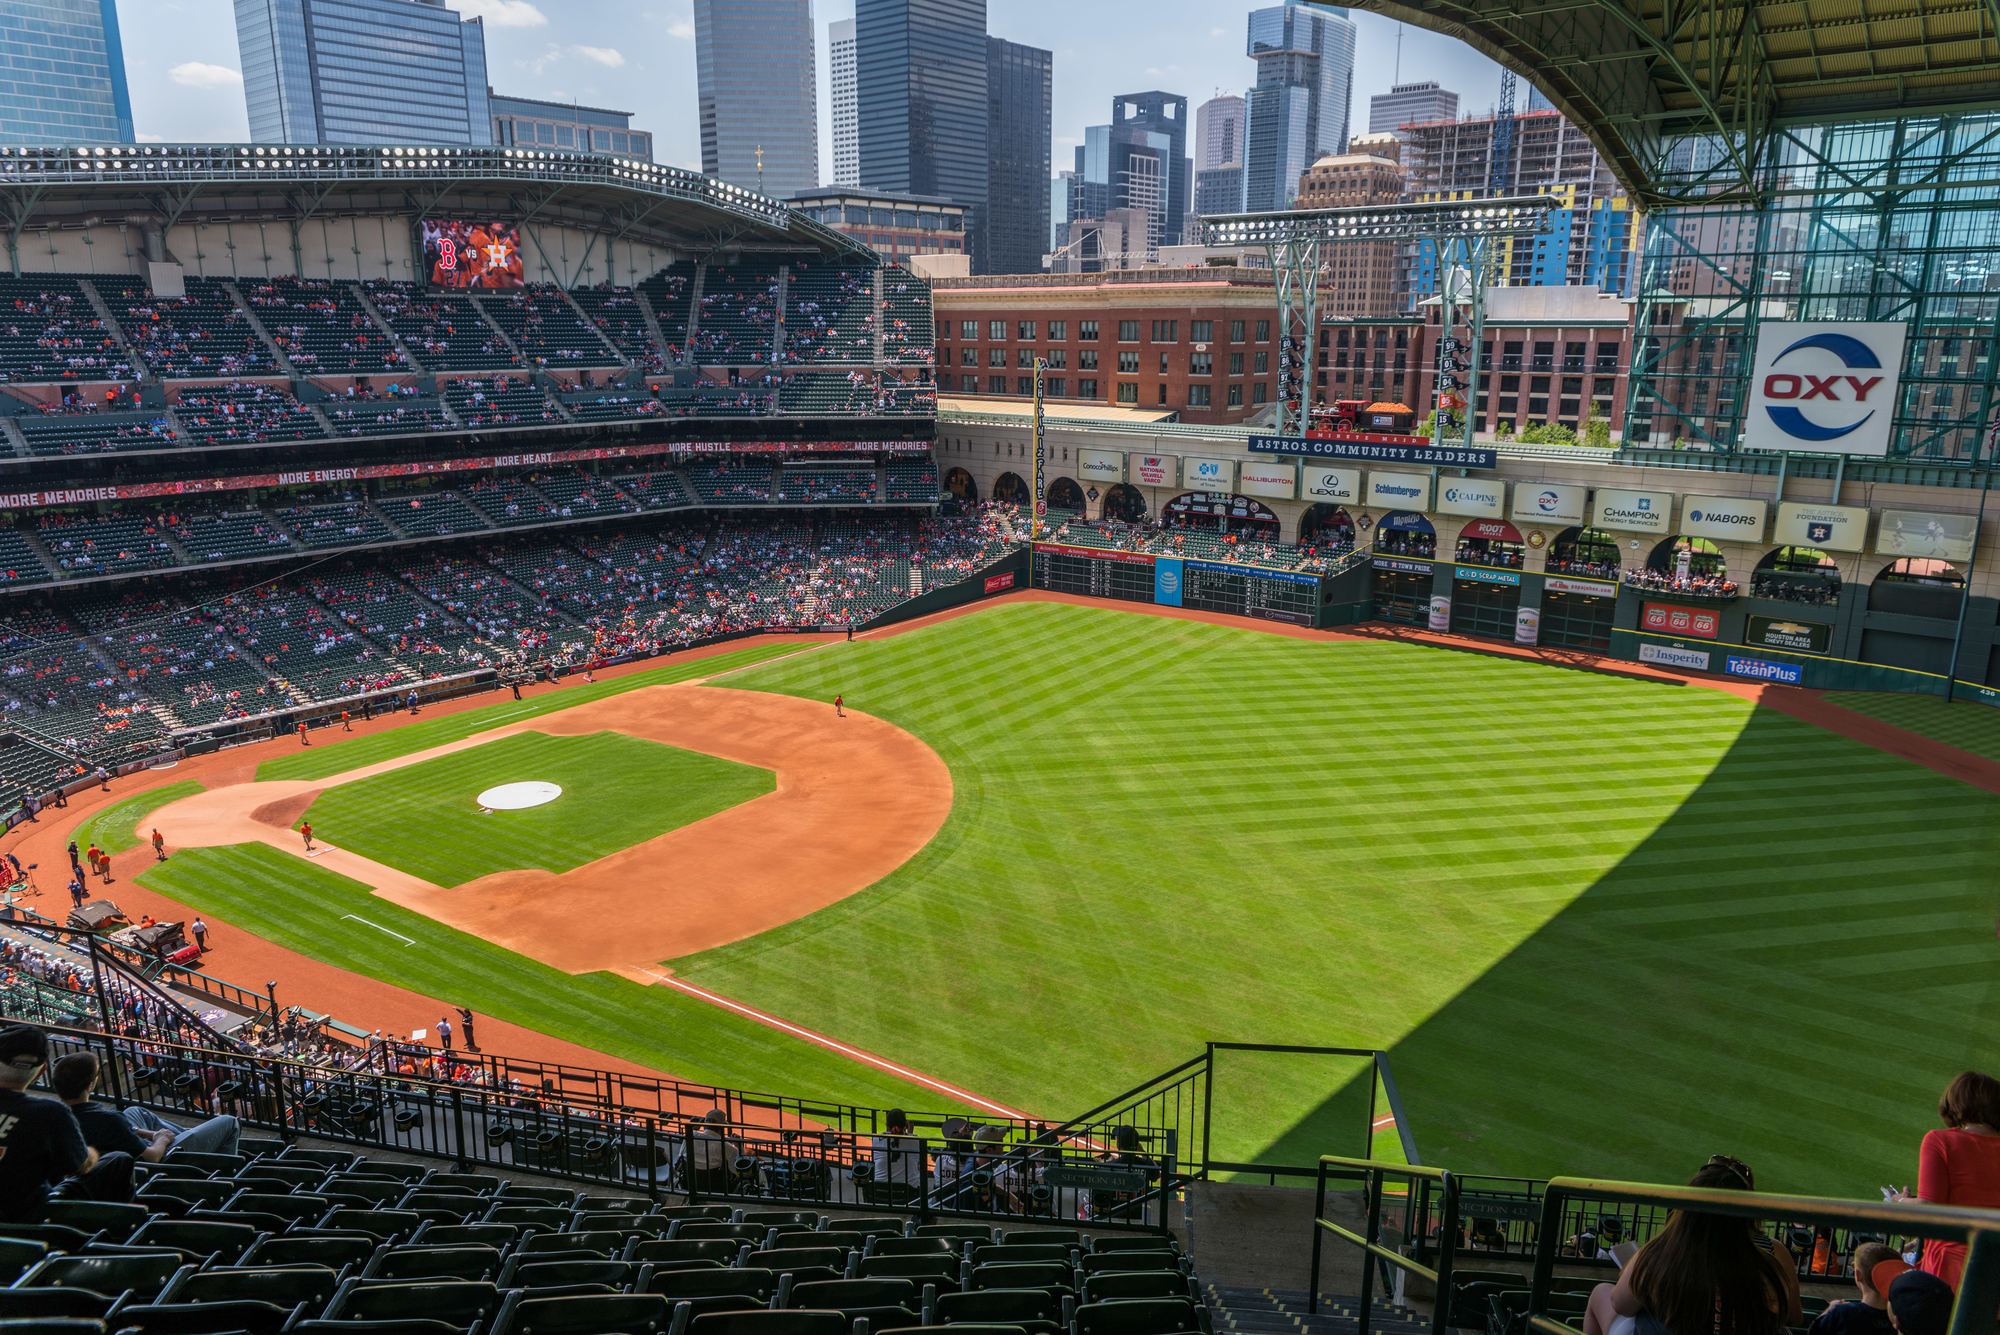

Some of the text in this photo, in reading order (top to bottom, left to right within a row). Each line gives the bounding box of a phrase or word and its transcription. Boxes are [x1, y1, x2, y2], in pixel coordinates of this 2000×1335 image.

[437, 238, 456, 269] B
[466, 249, 477, 259] VS
[1764, 374, 1885, 401] OXY
[669, 442, 731, 451] MORE HUSTLE
[854, 442, 927, 451] MORE MEMORIES
[1314, 443, 1408, 458] COMMUNITY
[1414, 450, 1486, 463] LEADERS
[495, 453, 552, 467] MORE HEART
[1083, 462, 1119, 473] ConocoPhillips
[1139, 466, 1166, 474] NATIONAL
[278, 468, 359, 485] MORE ENERGY
[1242, 475, 1293, 485] HALLIBURTON
[1310, 488, 1350, 497] LEXUS
[1375, 484, 1421, 498] Schlumberger
[0, 487, 117, 508] MORE MEMORIES
[1459, 493, 1497, 502] CALPINE
[1604, 507, 1660, 520] CHAMPION
[1705, 513, 1756, 525] NABORS
[1796, 514, 1849, 523] FOUNDATION
[1479, 524, 1505, 533] ROOT
[1398, 562, 1413, 570] TOWN
[1479, 572, 1496, 580] SCRAP
[1765, 632, 1794, 641] HOUSTON
[1784, 640, 1811, 648] DEALERS
[1656, 649, 1706, 667] Insperity
[1729, 660, 1796, 681] TexanPlus
[1062, 1173, 1108, 1184] SECTION
[1458, 1203, 1508, 1214] SECTION
